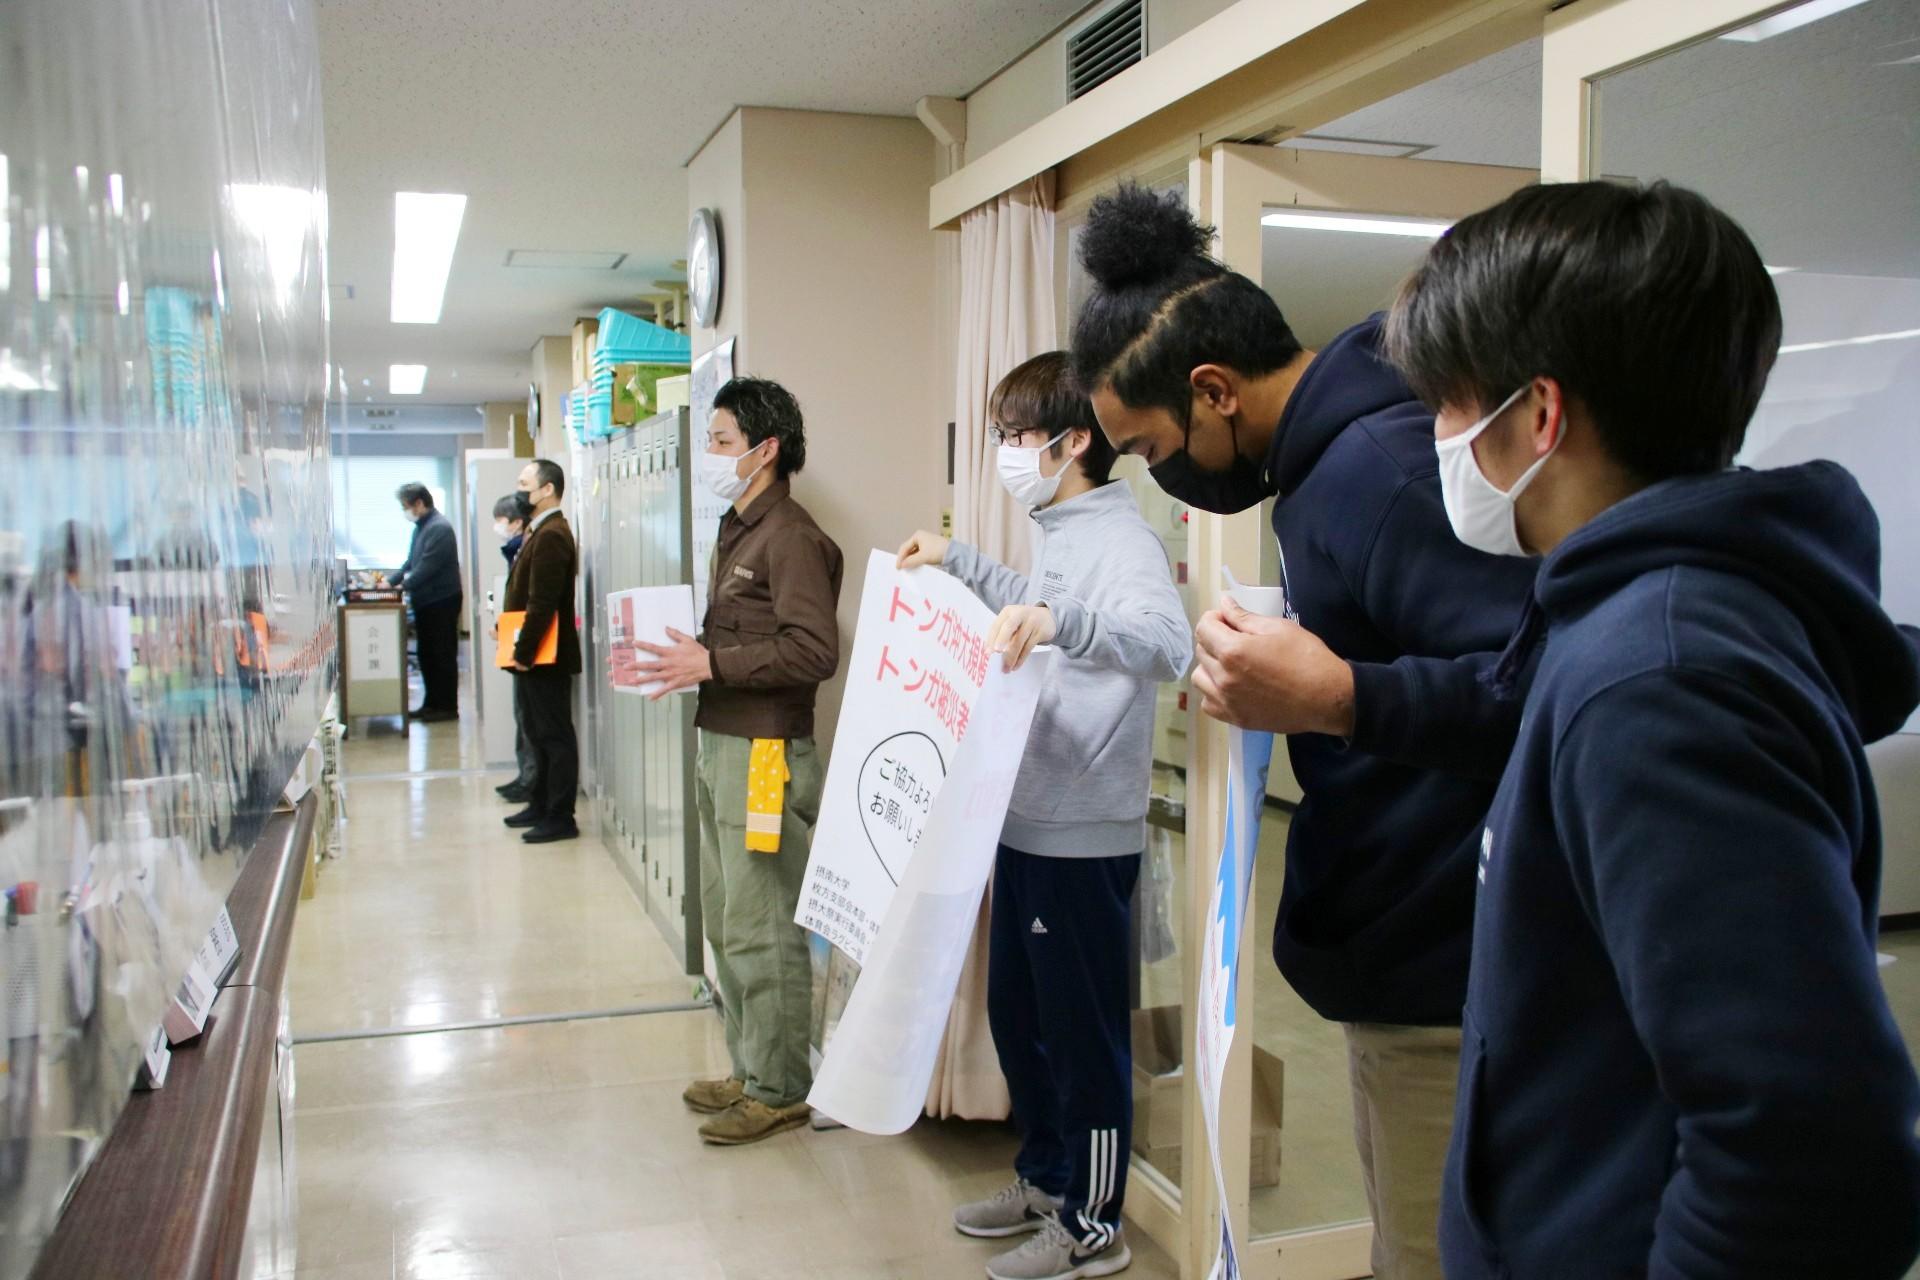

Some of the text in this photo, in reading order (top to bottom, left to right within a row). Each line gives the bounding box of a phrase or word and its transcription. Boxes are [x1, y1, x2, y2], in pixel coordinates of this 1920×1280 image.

[876, 644, 970, 743] トンガ被災者
[880, 757, 935, 814] ご協力よろ
